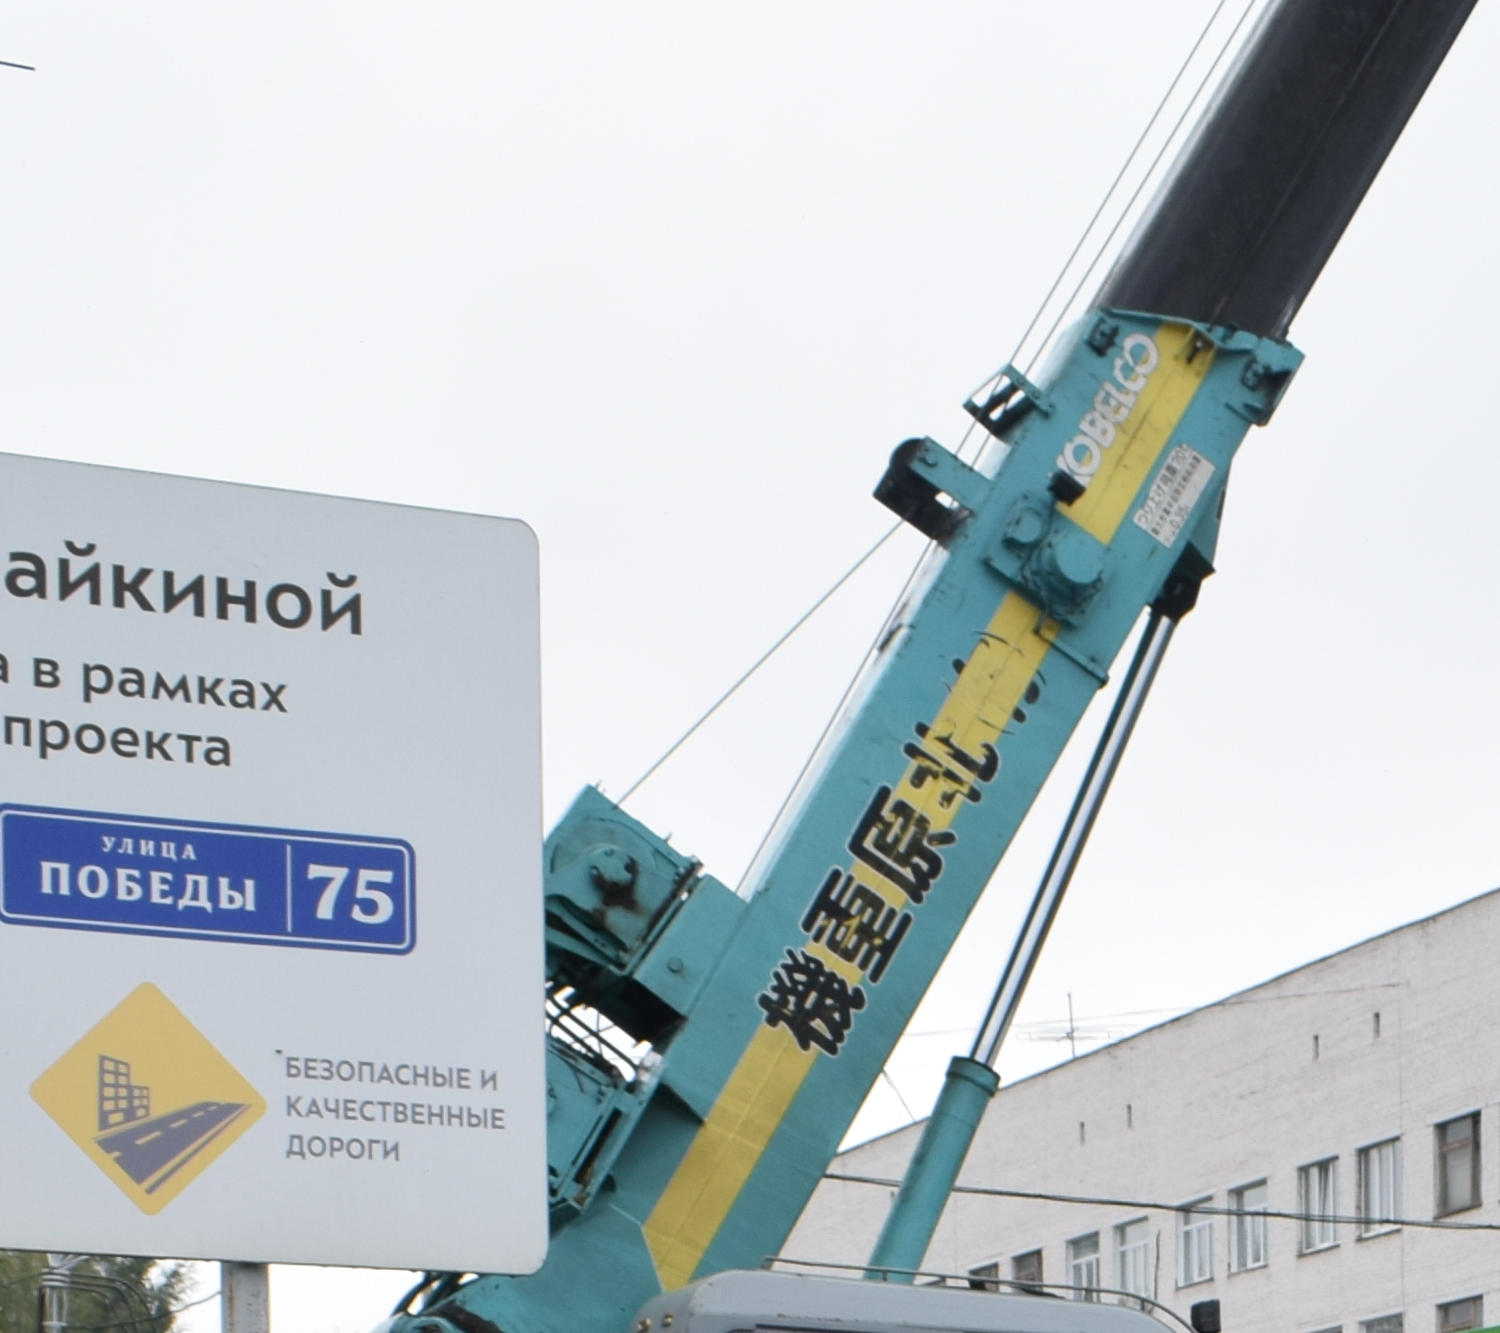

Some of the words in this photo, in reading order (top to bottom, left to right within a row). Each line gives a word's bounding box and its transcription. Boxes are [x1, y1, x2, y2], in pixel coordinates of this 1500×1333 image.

[33, 657, 61, 689] в
[82, 663, 289, 713] рамках
[4, 714, 232, 768] проекта
[102, 834, 198, 861] УЛИЦА
[40, 860, 256, 914] ПОБЕДЫ
[307, 863, 395, 925] 75
[286, 1056, 471, 1090] БЕЗОПАСНЫЕ
[480, 1069, 498, 1092] И
[286, 1095, 505, 1130] КАЧЕСТВЕННЫЕ
[285, 1134, 400, 1162] ДОРОГИ
